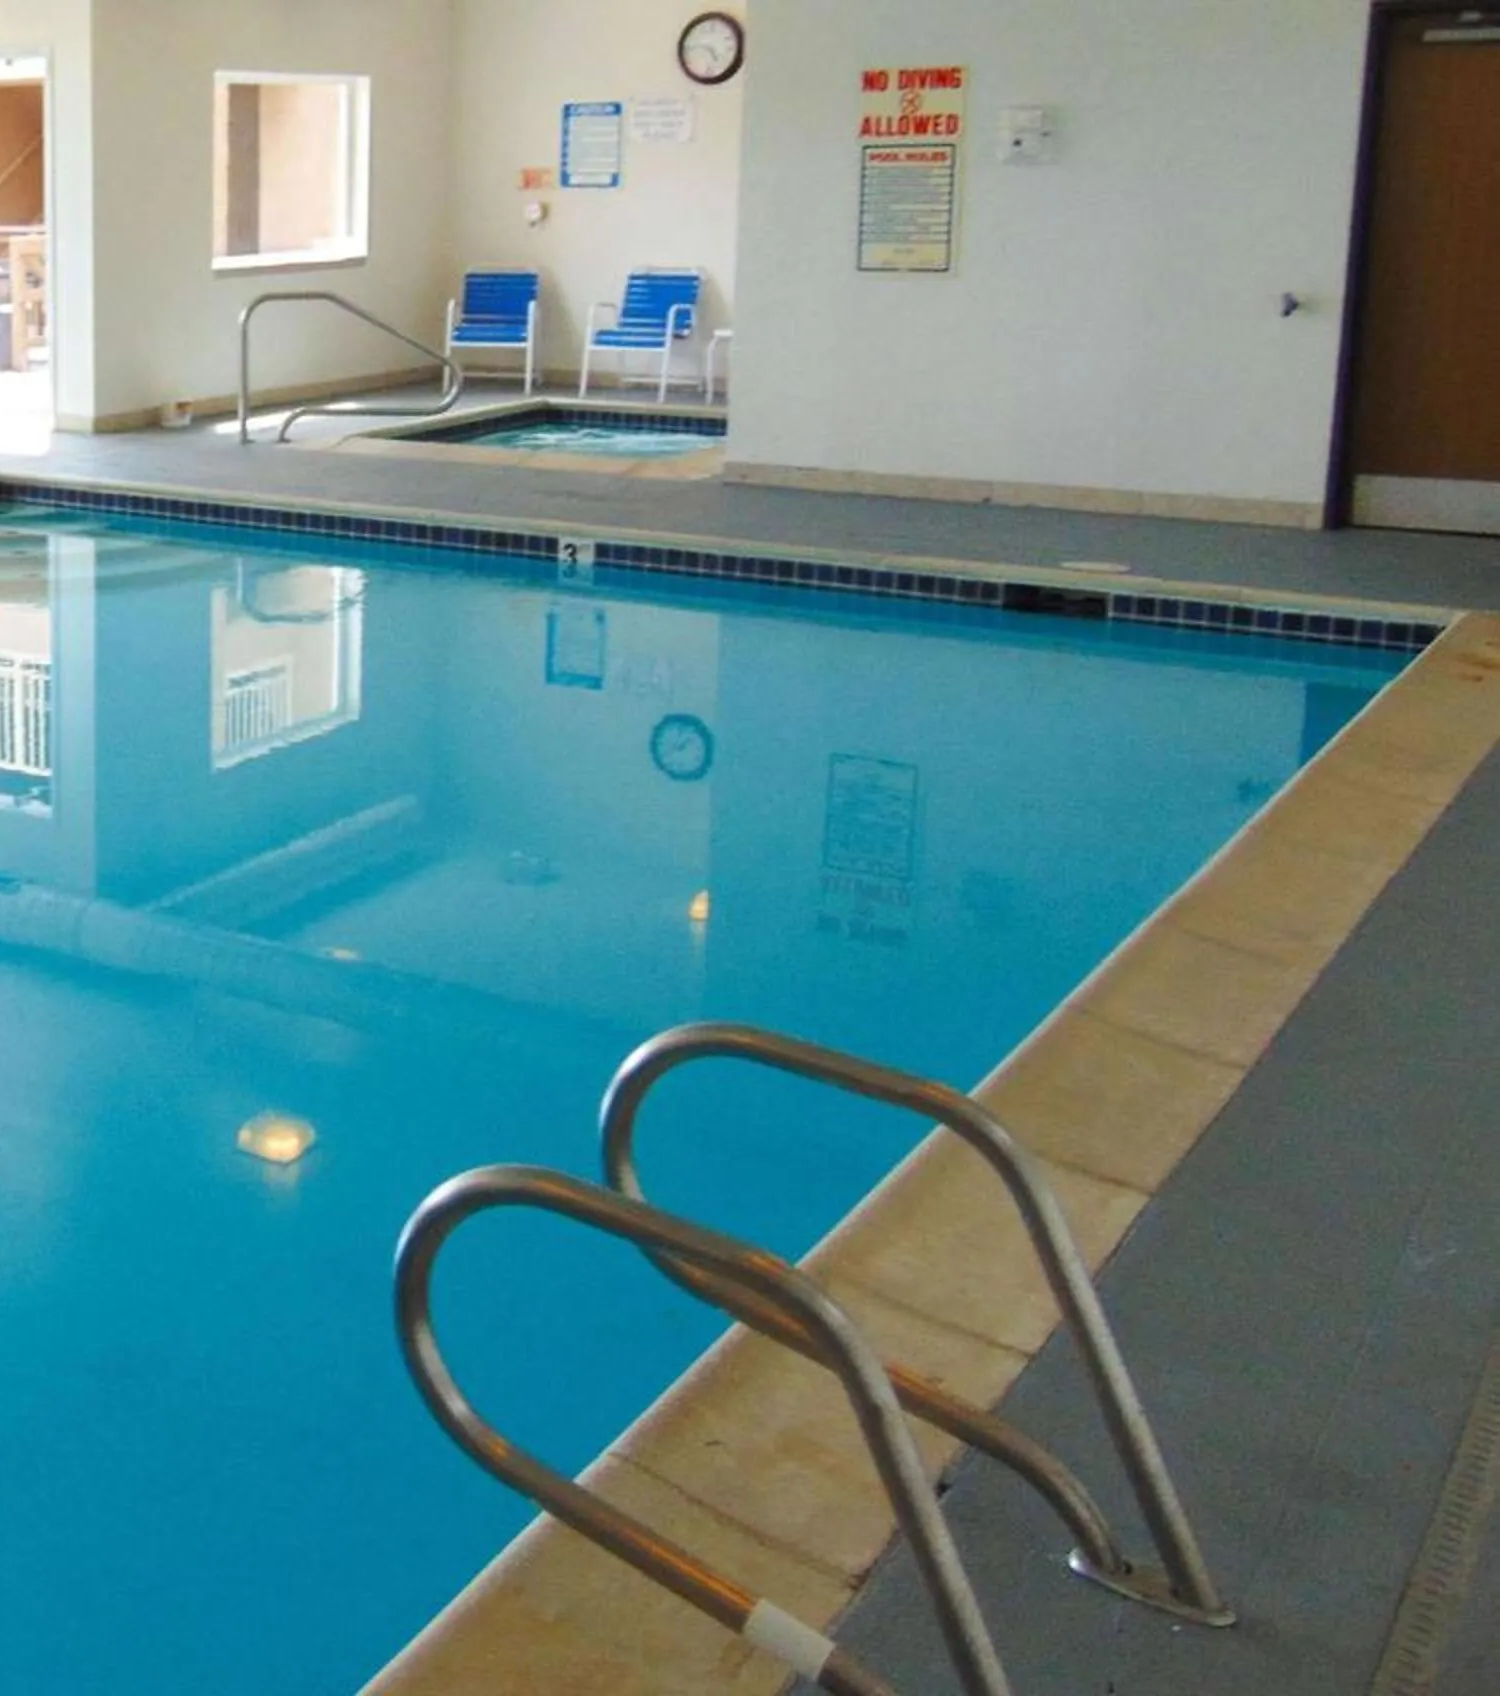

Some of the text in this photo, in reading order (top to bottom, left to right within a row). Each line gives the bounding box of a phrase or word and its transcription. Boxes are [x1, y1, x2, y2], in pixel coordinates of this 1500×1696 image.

[862, 68, 962, 92] NO DIVING
[860, 114, 959, 138] ALLOWED
[563, 543, 577, 567] 3
